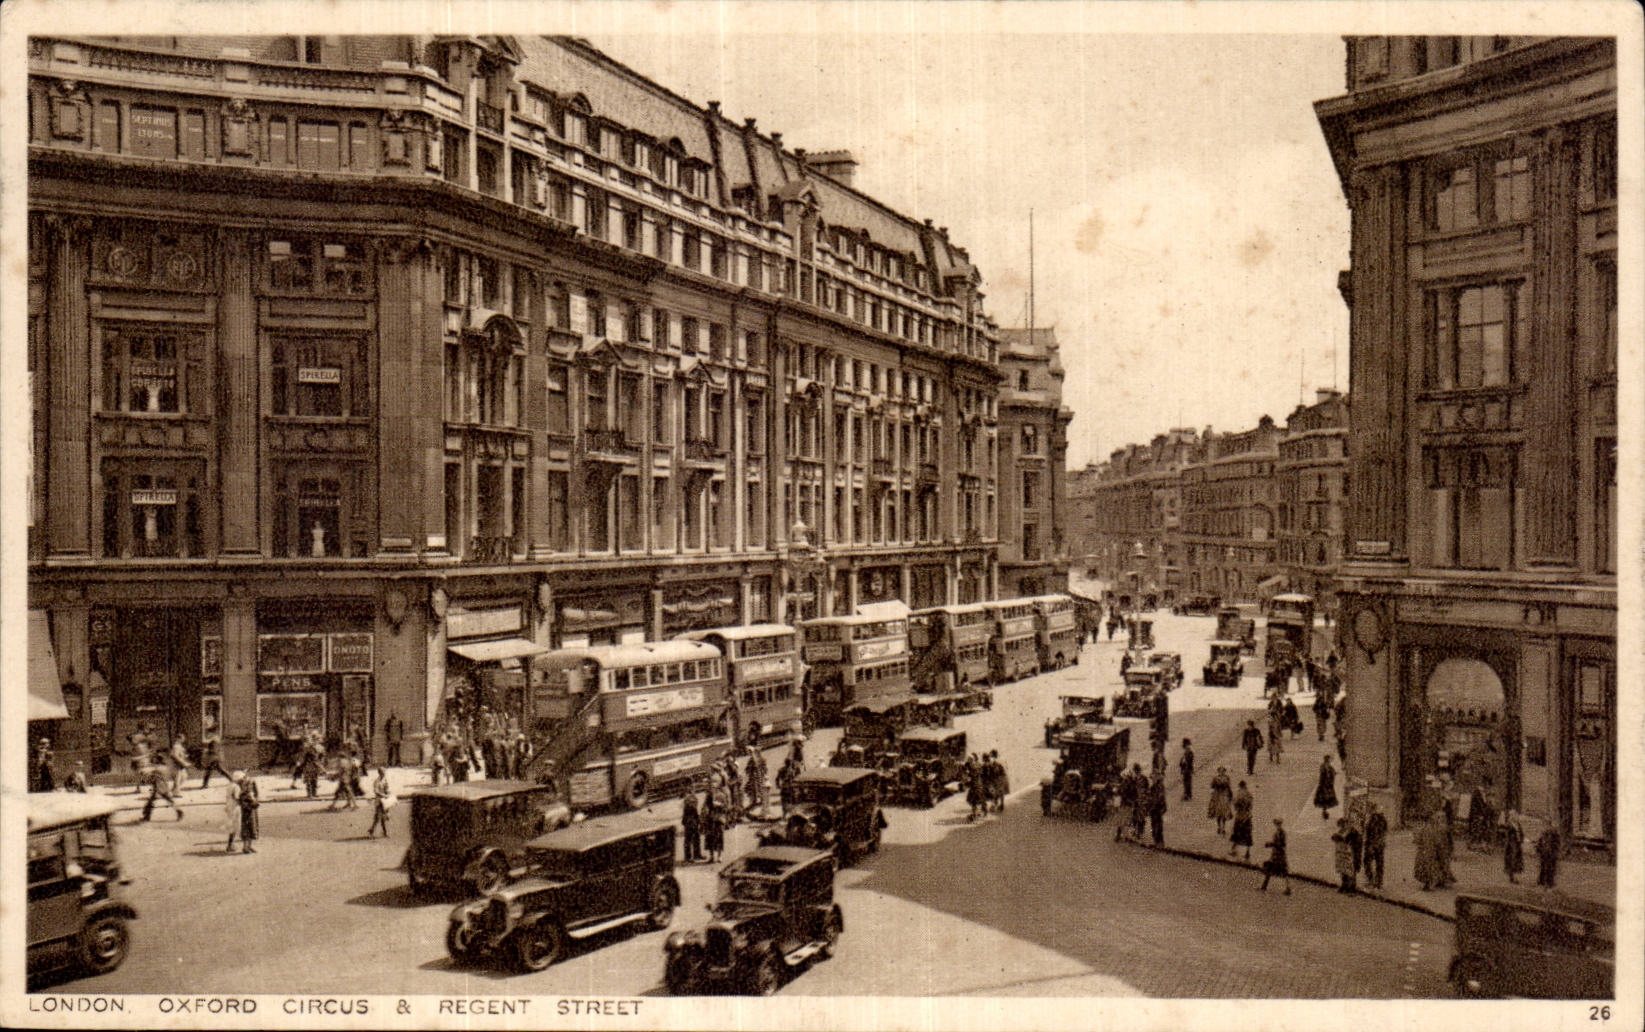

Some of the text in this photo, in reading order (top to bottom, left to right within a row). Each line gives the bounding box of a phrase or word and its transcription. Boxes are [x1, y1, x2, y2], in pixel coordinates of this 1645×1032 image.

[299, 370, 340, 381] SPIRELLA
[132, 491, 175, 503] SPIRELLA
[333, 645, 370, 655] ONOTO
[272, 677, 311, 687] PENS
